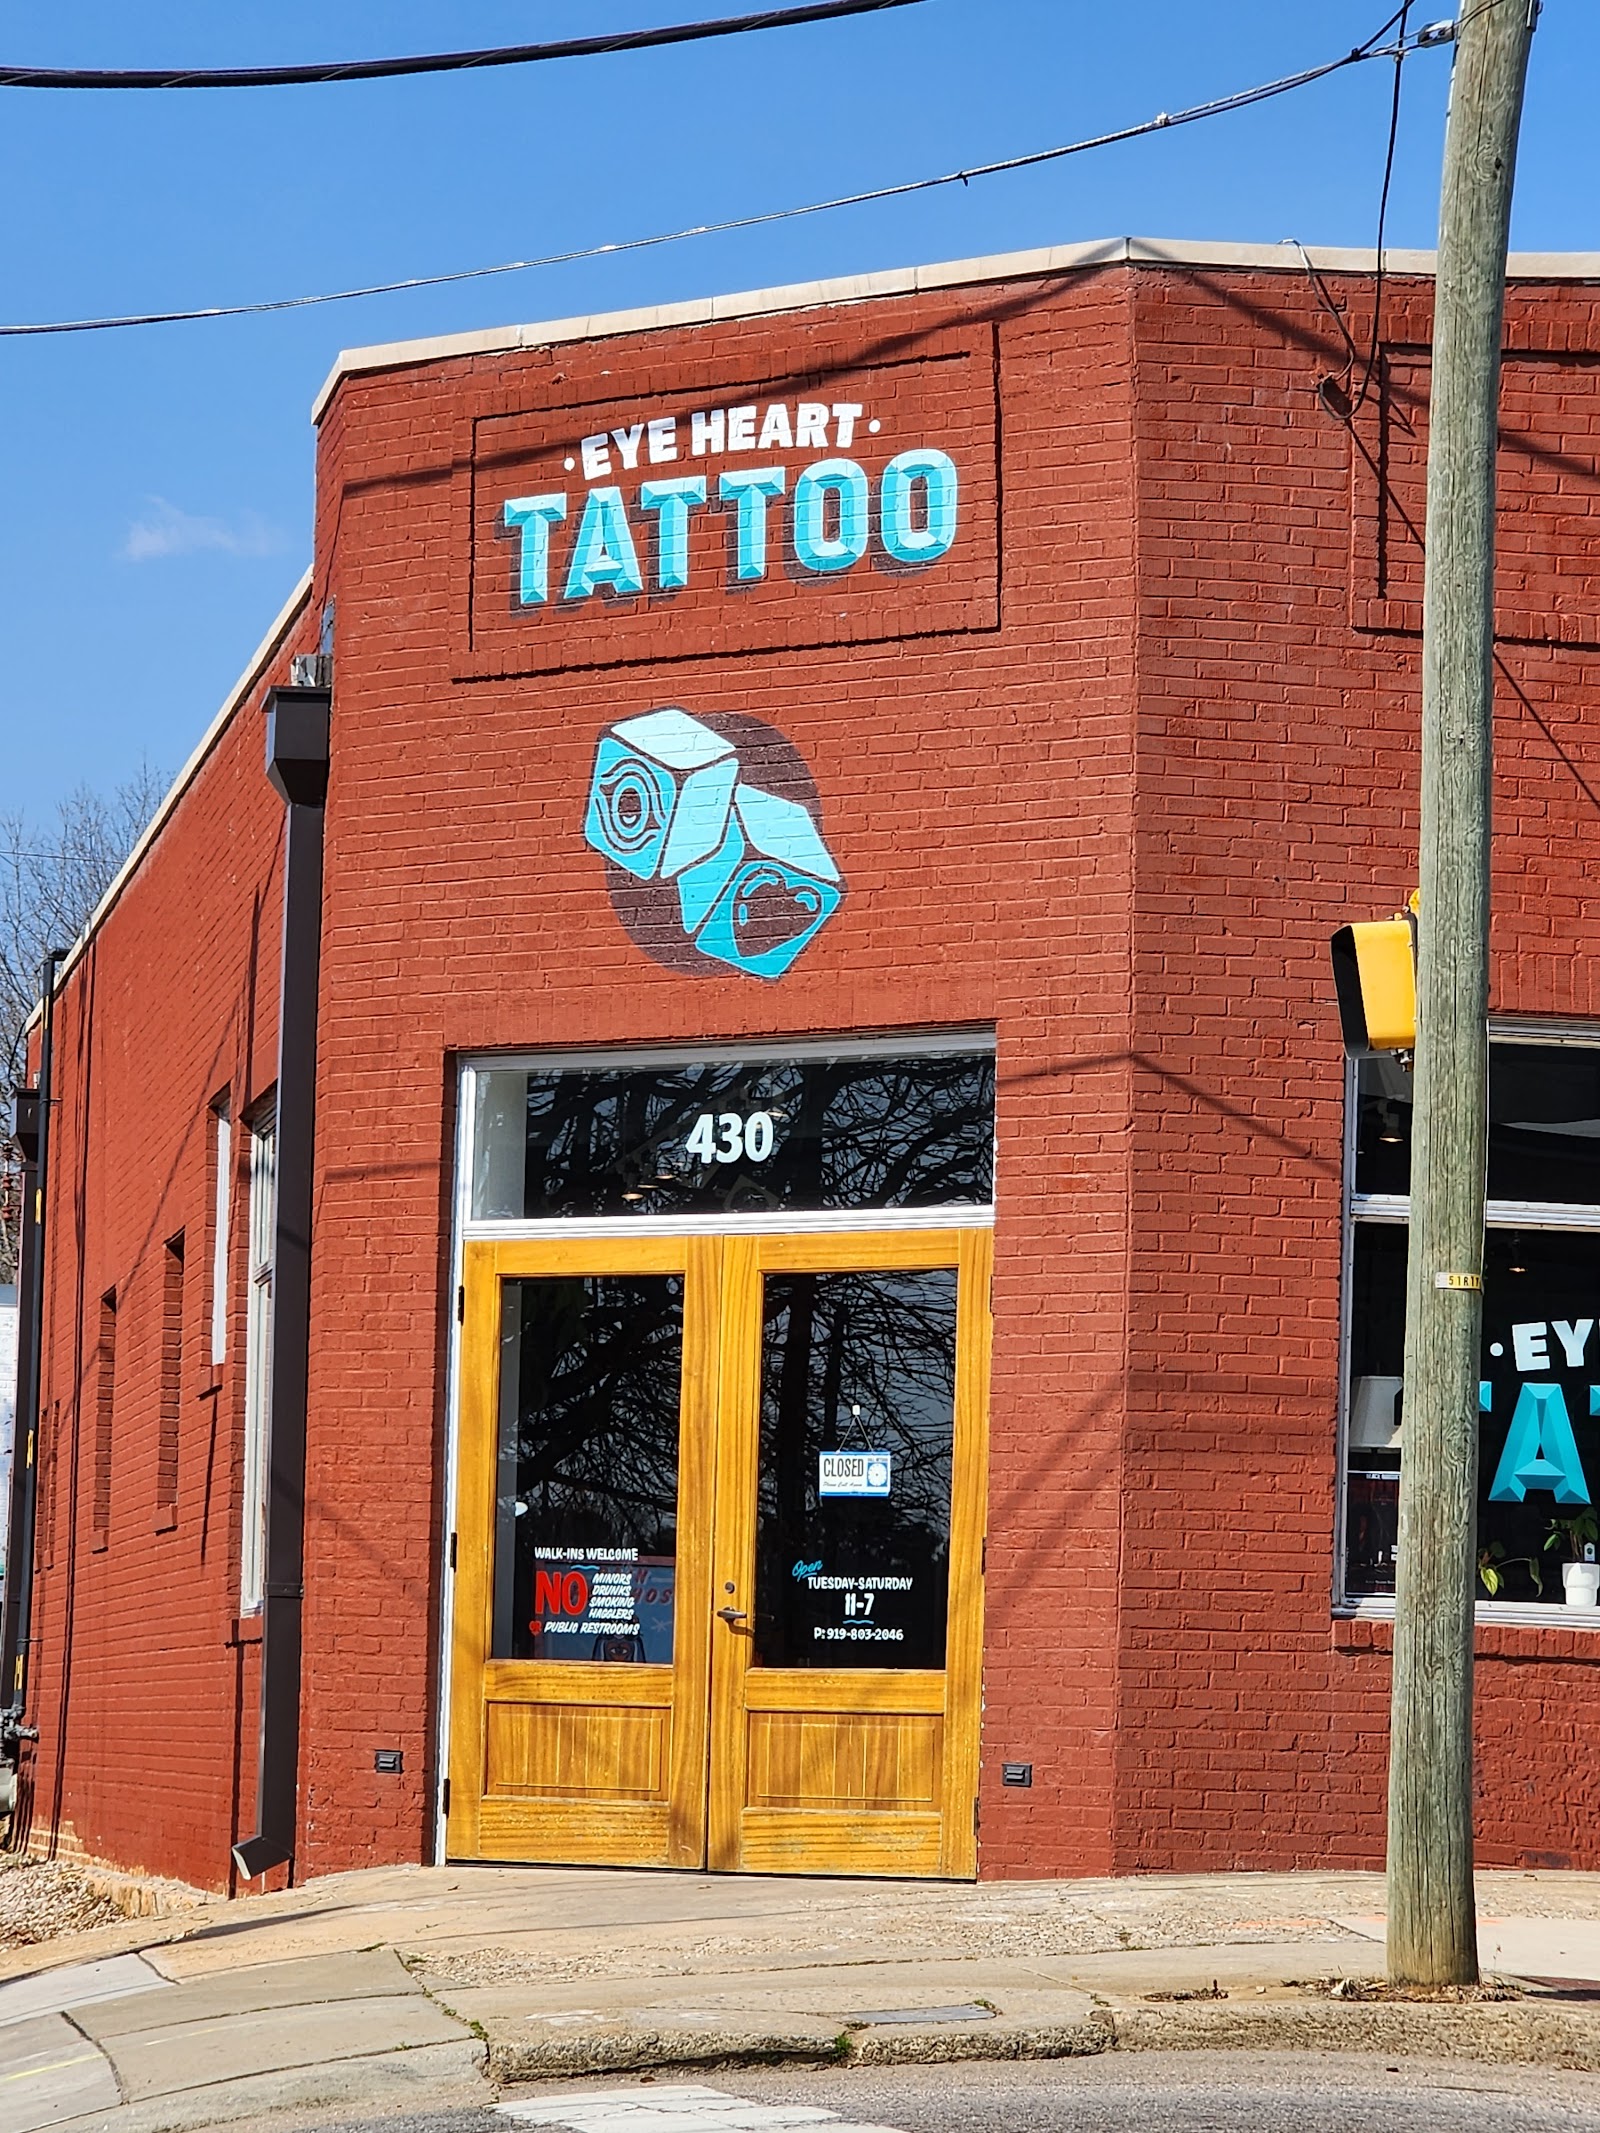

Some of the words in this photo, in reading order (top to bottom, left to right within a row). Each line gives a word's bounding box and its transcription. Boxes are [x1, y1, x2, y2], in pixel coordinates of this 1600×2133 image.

[580, 417, 677, 480] EYE
[691, 403, 862, 457] HEART
[503, 448, 958, 606] TATTOO
[685, 1111, 774, 1164] 430
[1511, 1318, 1600, 1372] EY
[823, 1458, 864, 1477] CLOSED
[534, 1546, 585, 1560] WALK-INS
[586, 1548, 639, 1561] WELCOME
[592, 1573, 632, 1585] MINORS
[792, 1560, 823, 1582] Open
[592, 1585, 632, 1597] DRUNKS
[807, 1576, 913, 1590] TUESDAY-SATURDAY
[535, 1570, 588, 1616] NO
[588, 1597, 636, 1608] SMOKING
[844, 1593, 875, 1616] 11-7
[588, 1608, 635, 1621] HAGGLERS
[544, 1621, 578, 1634] PUBLIC
[580, 1622, 640, 1636] RESTROOMS
